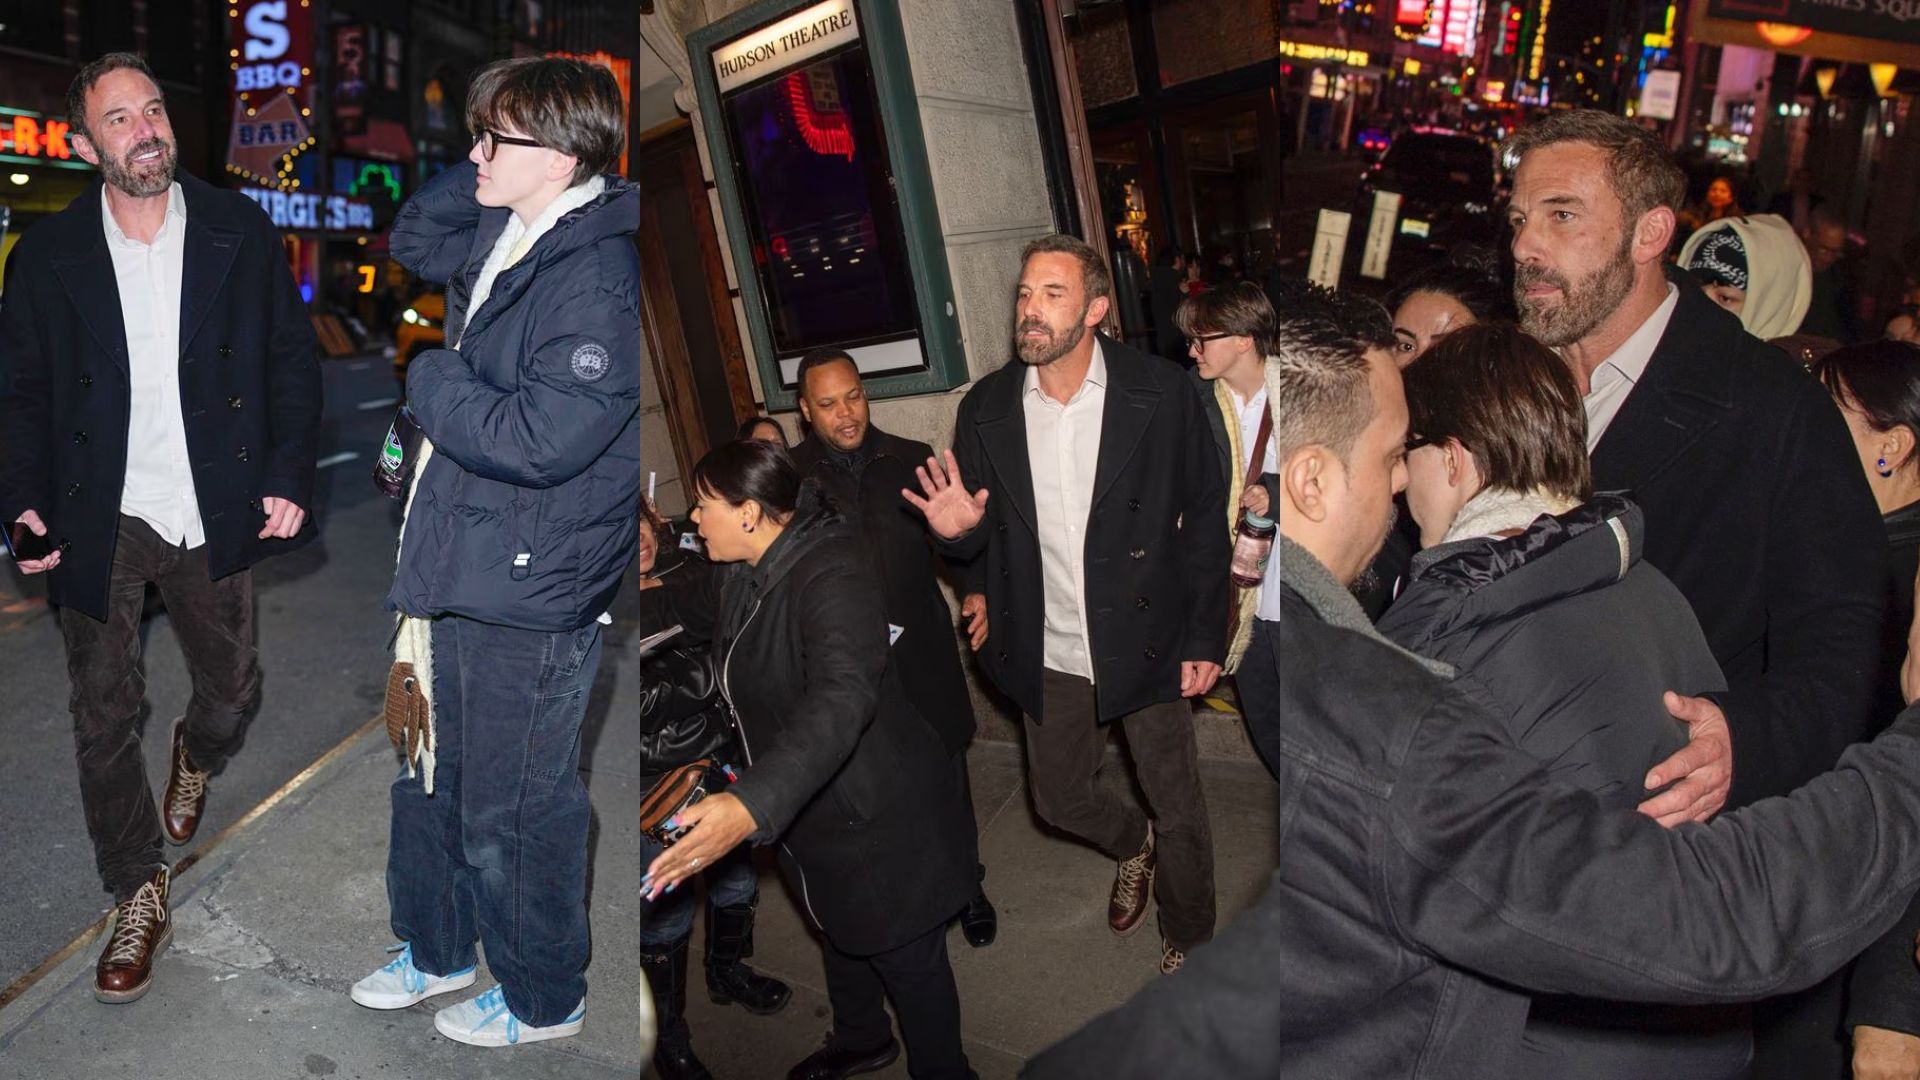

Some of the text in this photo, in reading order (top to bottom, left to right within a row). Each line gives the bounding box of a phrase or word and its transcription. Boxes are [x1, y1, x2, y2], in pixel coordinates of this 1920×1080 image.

[719, 9, 852, 78] HUDSON THEATRE
[235, 61, 301, 91] BBQ
[239, 121, 297, 145] BAR
